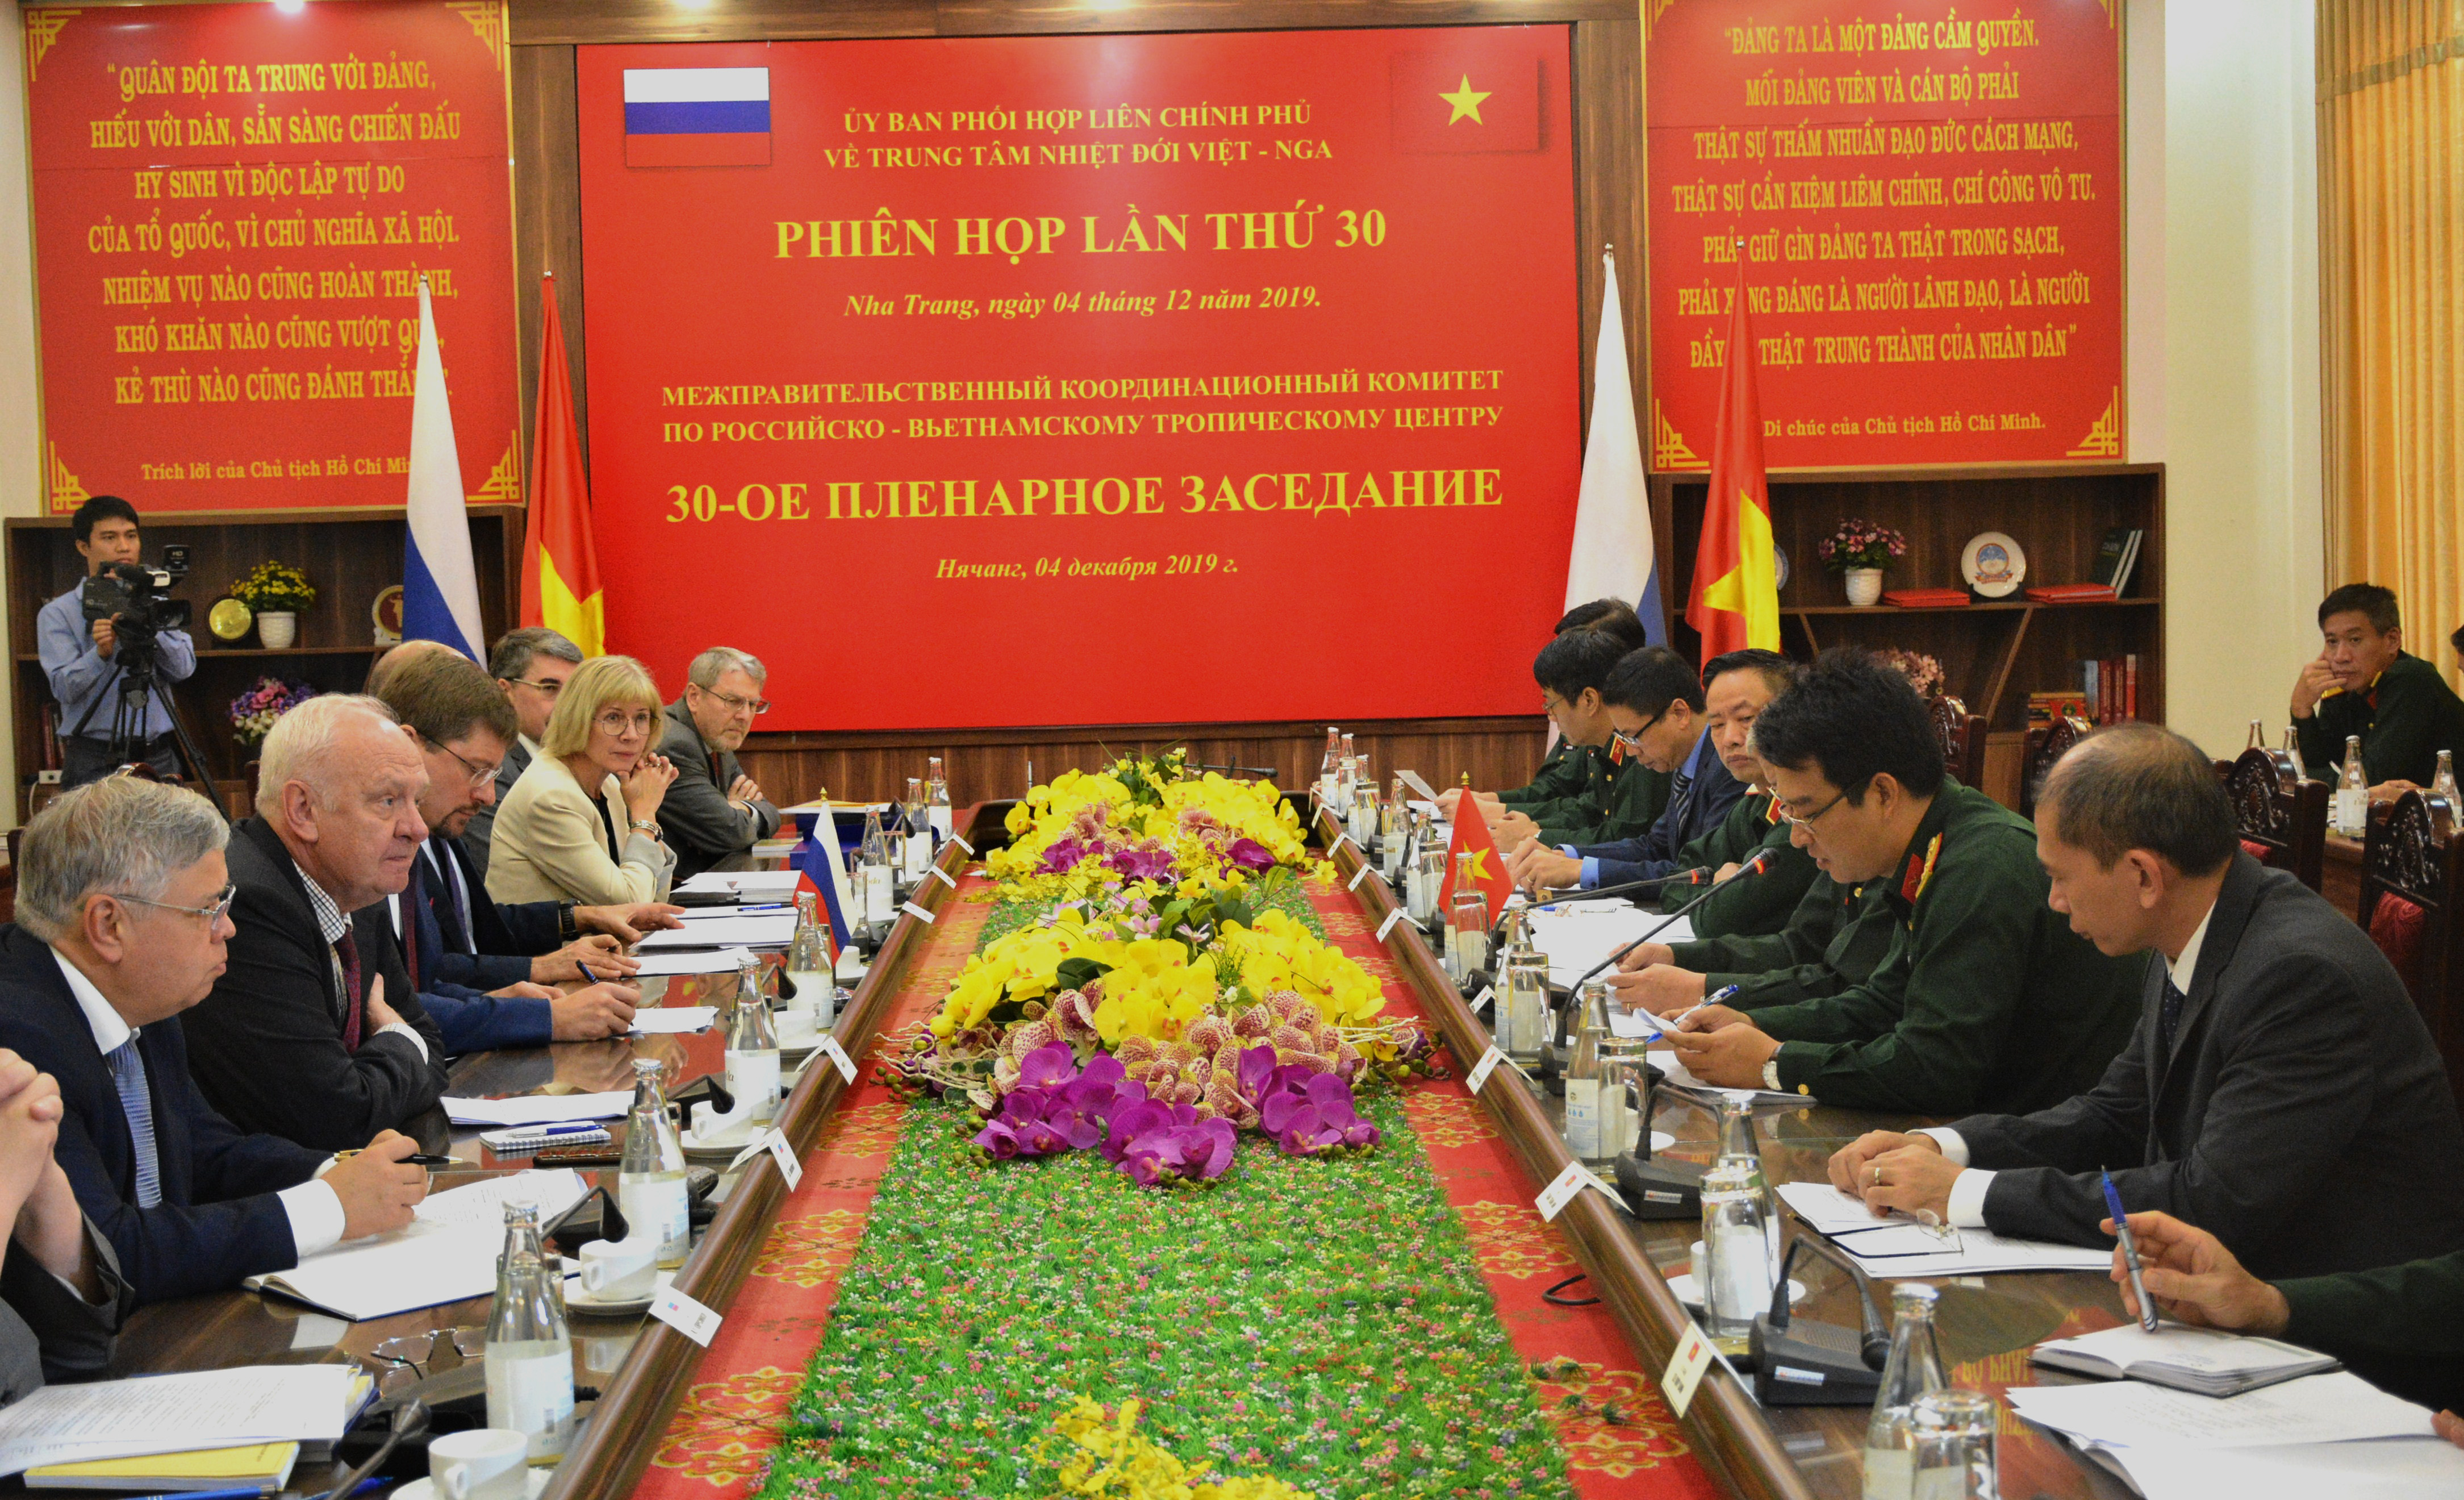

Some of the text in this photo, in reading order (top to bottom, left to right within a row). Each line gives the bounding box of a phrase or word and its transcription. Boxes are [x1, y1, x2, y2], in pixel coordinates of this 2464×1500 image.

[1785, 26, 1809, 52] TA
[1812, 18, 1835, 52] LÀ
[1839, 16, 1876, 57] MỘT
[1881, 13, 1930, 51] ĐẢNG
[1934, 7, 1972, 49] CẦM
[1977, 7, 2039, 56] QUYỀN.
[182, 59, 219, 99] ĐỘI
[223, 65, 253, 93] TA
[256, 63, 327, 92] TRUNG
[330, 52, 367, 90] VỚI
[1784, 69, 1831, 105] ĐẢNG
[1836, 70, 1877, 103] VIÊN
[1881, 68, 1906, 103] VÀ
[1910, 67, 1944, 102] CÁN
[1950, 66, 1973, 106] BỘ
[1978, 61, 2020, 100] PHẢI
[90, 100, 461, 148] HIẾU VỚI DÂN, SẴN SÀNG CHIẾN ĐẤU
[845, 99, 1310, 134] ỦY BAN PHỐI HỢP LIÊN CHÍNH PHỦ
[824, 143, 860, 168] VỀ
[867, 147, 962, 168] TRUNG
[970, 140, 1031, 166] TÂM
[1041, 142, 1125, 169] NHIỆT
[1133, 138, 1180, 164] ĐỚI
[1188, 139, 1252, 166] VIỆT
[1276, 140, 1333, 159] NGA
[1694, 116, 2079, 164] THẬT SỰ THẤM NHUẦN ĐẠO ĐỨC CÁCH MẠNG,
[135, 160, 405, 202] HY SINH VÌ ĐỘC LẬP TỰ DO
[1672, 178, 1718, 218] THẬT
[1723, 180, 1746, 216] SỰ
[1751, 170, 1785, 210] CẦN
[1791, 175, 1836, 214] KIỆM
[1841, 174, 1884, 207] LIÊM
[1889, 172, 1949, 206] CHÍNH,
[1953, 170, 1984, 205] CHÍ
[1989, 169, 2035, 203] CÔNG
[2040, 167, 2063, 201] VÔ
[89, 208, 460, 258] CỦA TỔ QUỐC, VÌ CHỦ NGHĨA XÃ HỘI.
[775, 199, 1386, 265] PHIÊN HỌP LẦN THỨ 30
[1703, 223, 2065, 263] PHẢ GIỮ GÌN ĐẢNG TA THẬT TRONG SẠCH,
[103, 269, 171, 309] NHIỆM
[176, 275, 203, 307] VỤ
[210, 265, 252, 301] NÀO
[258, 266, 314, 300] CŨNG
[319, 263, 375, 298] HOÀN
[845, 286, 1321, 320] Nha Trang, ngày 04 tháng 12 năm 2019.
[1679, 270, 2091, 316] PHẢI XNG ĐÁNG LÀ NGƯỜI LÃNH ĐẠO, LÀ NGƯỜI
[115, 318, 159, 353] KHÓ
[166, 318, 223, 351] KHĂN
[229, 315, 270, 349] NÀO
[277, 315, 332, 348] CŨNG
[337, 316, 391, 353] VƯỢT
[1690, 328, 1726, 368] ĐẦY
[1759, 331, 1805, 370] THẬT
[1814, 336, 1871, 364] TRUNG
[1876, 328, 1935, 363] THÀNH
[1940, 323, 1977, 361] CỦA
[1979, 324, 2027, 359] NHÂN
[115, 366, 144, 404] KẺ
[151, 368, 191, 403] THÙ
[199, 367, 239, 402] NÀO
[246, 367, 302, 402] CŨNG
[307, 364, 365, 399] ĐÁNH
[663, 368, 1504, 406] МЕЖПРАВИТЕЛЬСТВЕННЫЙ КООРДИНАЦИОННЫЙ КОМИТЕТ
[664, 423, 704, 443] ПО
[712, 416, 886, 441] РОССИЙСКО
[909, 415, 1144, 438] ВЬЕТНАМСКОМУ
[1152, 409, 1385, 434] ТРОПИЧЕСКОМУ
[1395, 406, 1504, 430] ЦЕНТРУ
[1765, 411, 2046, 436] Di chúc của Chủ tịch Hồ Chí Minh.
[141, 463, 185, 480] Trích
[190, 463, 212, 480] lời
[216, 461, 246, 478] của
[251, 459, 284, 478] Chủ
[289, 460, 321, 480] tịch
[327, 455, 349, 476] Hồ
[354, 458, 382, 475] Chí
[666, 469, 1502, 522] 30-ОЕ ПЛЕНАРНОЕ ЗАСЕДАНИЕ
[937, 554, 1238, 581] Нячанг, 04 декабря 2019 г.
